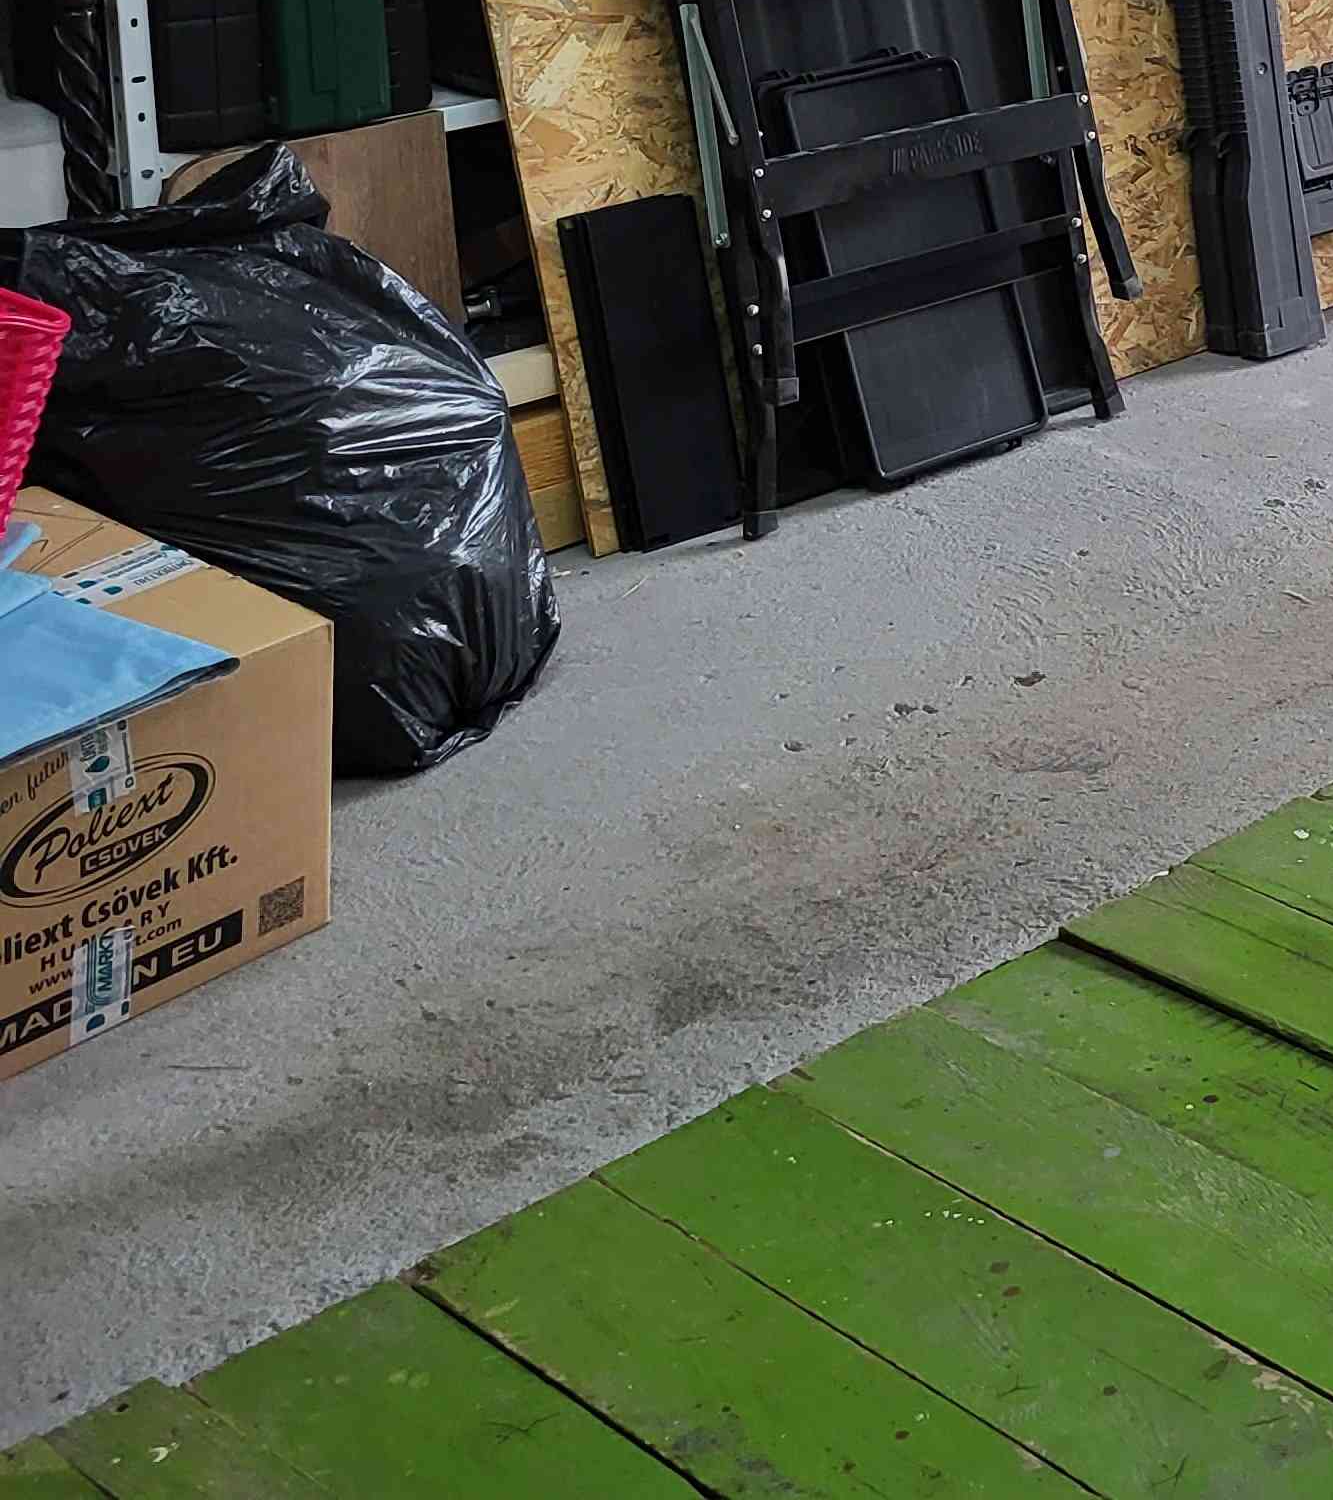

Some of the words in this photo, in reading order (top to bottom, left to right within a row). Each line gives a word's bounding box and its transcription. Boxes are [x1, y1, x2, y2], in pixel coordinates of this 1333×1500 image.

[908, 128, 984, 172] PARKSIDE
[29, 772, 174, 885] Poliext
[0, 912, 74, 965] liext
[81, 867, 181, 929] Csövek
[187, 843, 238, 884] Kft.
[0, 995, 73, 1049] MAD
[172, 926, 222, 968] EU
